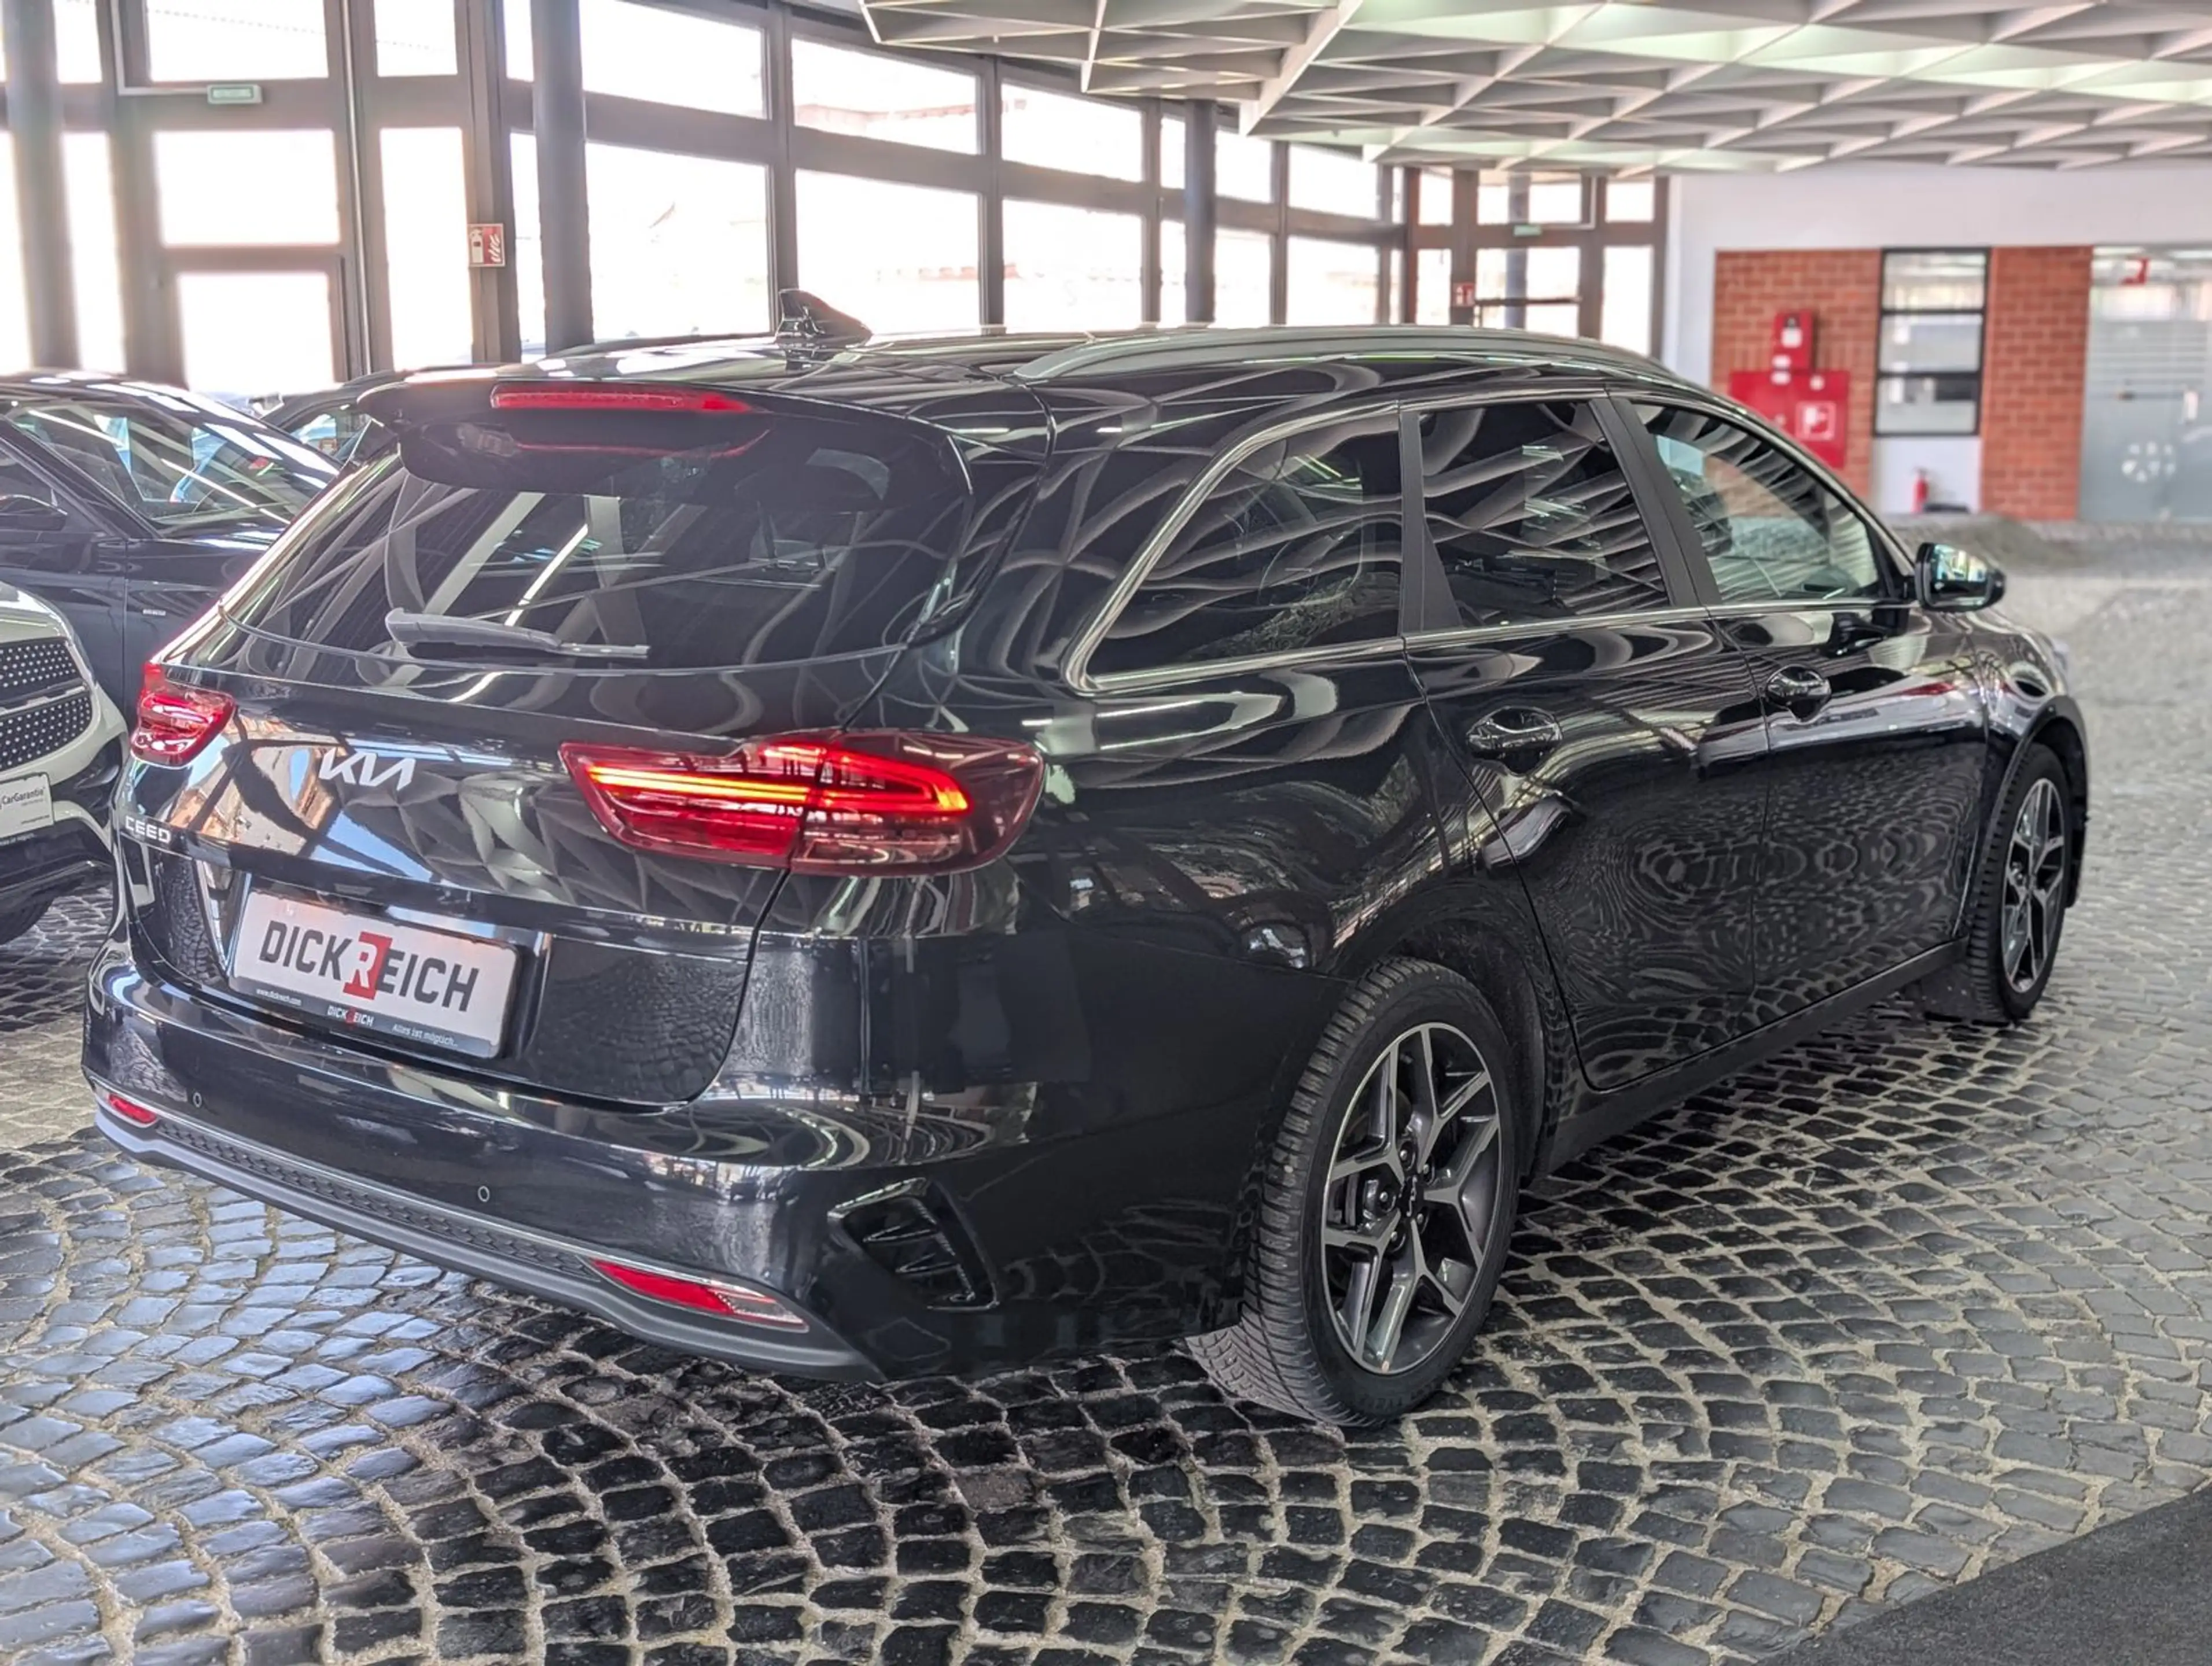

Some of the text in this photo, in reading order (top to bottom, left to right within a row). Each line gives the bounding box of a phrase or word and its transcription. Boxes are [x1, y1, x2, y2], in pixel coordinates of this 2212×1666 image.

[319, 747, 416, 791] KIA
[126, 816, 171, 843] CEED
[259, 920, 480, 1012] DICKREICH
